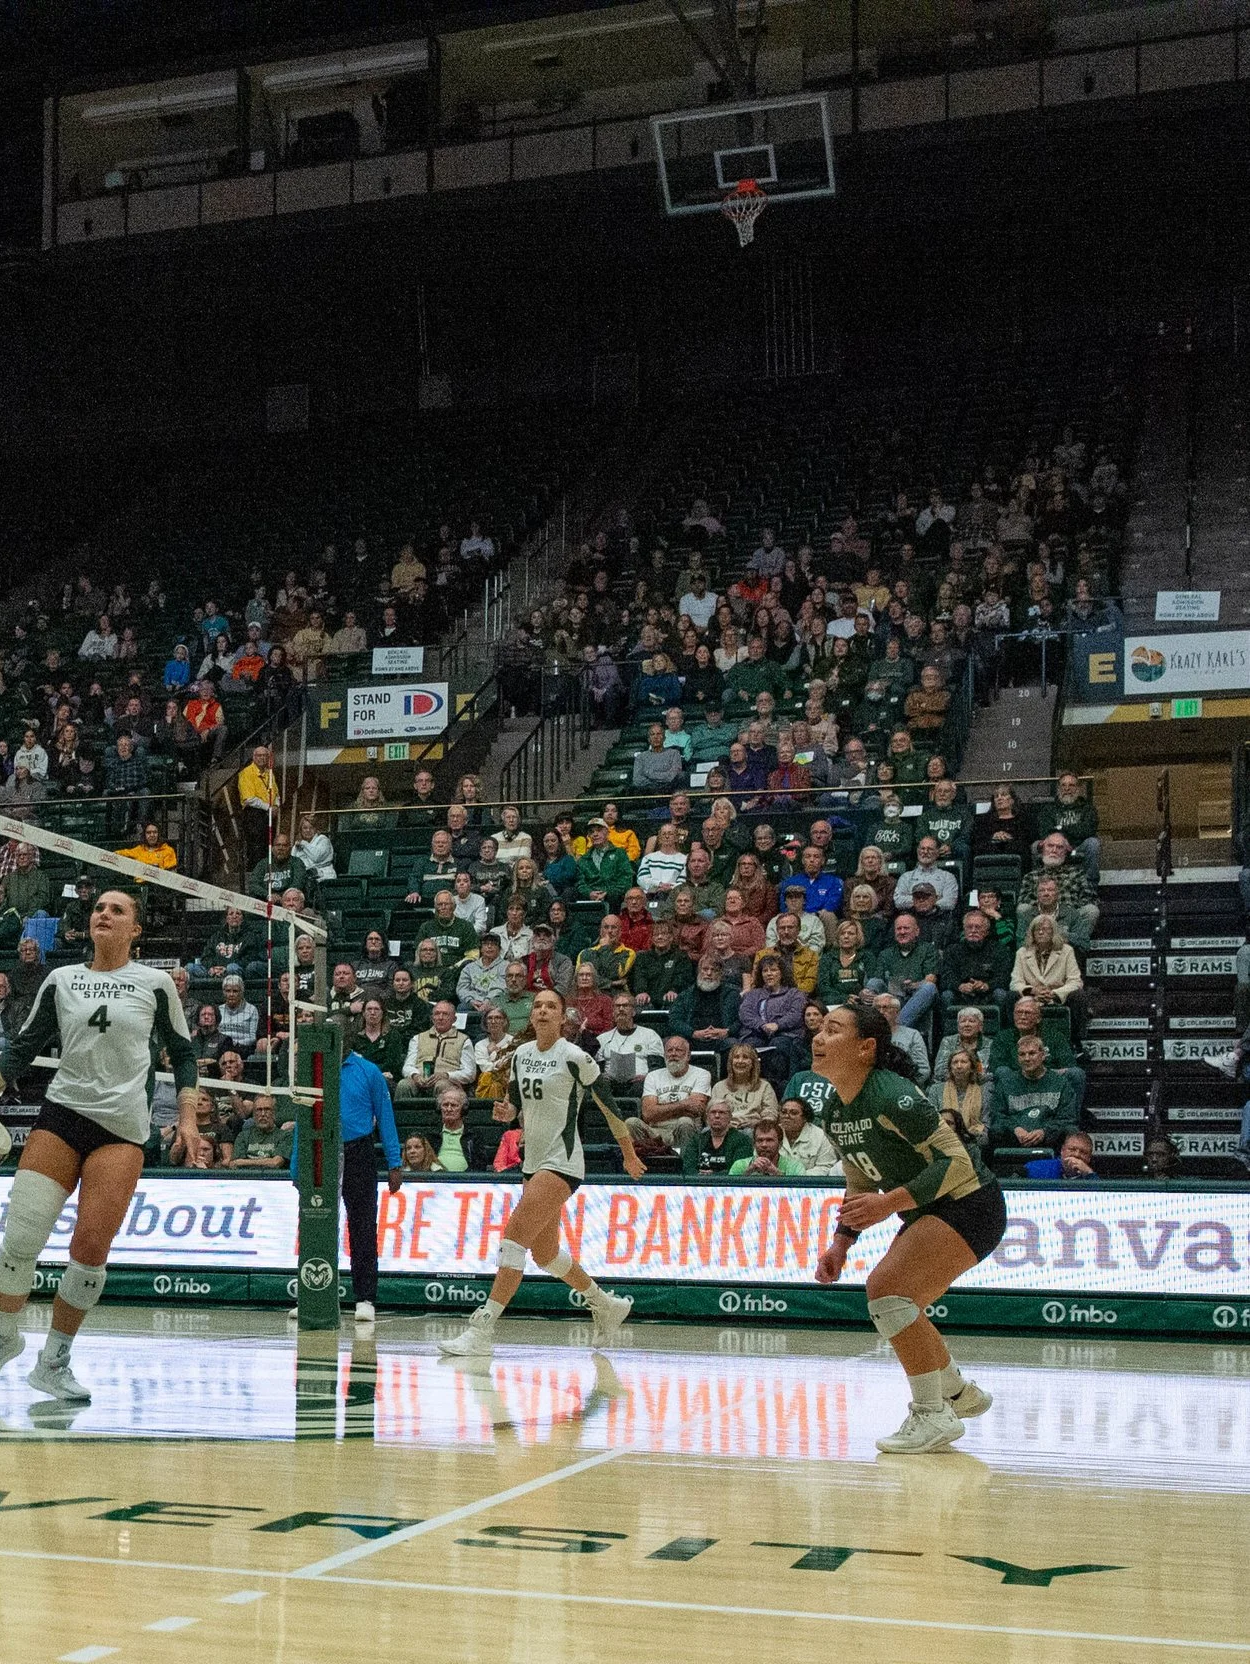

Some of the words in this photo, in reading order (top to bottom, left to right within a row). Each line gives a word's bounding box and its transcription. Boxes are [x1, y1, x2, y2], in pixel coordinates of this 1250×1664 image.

[1170, 651, 1202, 670] KRAZY
[1207, 649, 1246, 669] KARL'S
[1088, 653, 1117, 684] E
[353, 693, 391, 706] STAND
[320, 702, 342, 729] F
[353, 711, 376, 722] FOR
[1106, 963, 1149, 974] RAMS
[1189, 961, 1233, 973] RAMS
[70, 982, 136, 993] COLORADO
[83, 990, 121, 999] STATE
[88, 1005, 111, 1034] 4
[1100, 1047, 1145, 1058] RAMS
[521, 1057, 557, 1068] COLORADO
[525, 1066, 546, 1074] STATE
[521, 1077, 543, 1100] 26
[830, 1117, 873, 1134] COLORADO
[838, 1132, 865, 1146] STATE
[1094, 1140, 1142, 1152] RAMS
[1188, 1141, 1238, 1153] RAMS
[846, 1151, 883, 1182] 18
[115, 1192, 263, 1240] bout
[454, 1190, 586, 1264] THN
[174, 1275, 211, 1295] fnbo
[447, 1282, 487, 1302] fnbo
[743, 1293, 788, 1313] fnbo
[1069, 1302, 1118, 1324] fnbo
